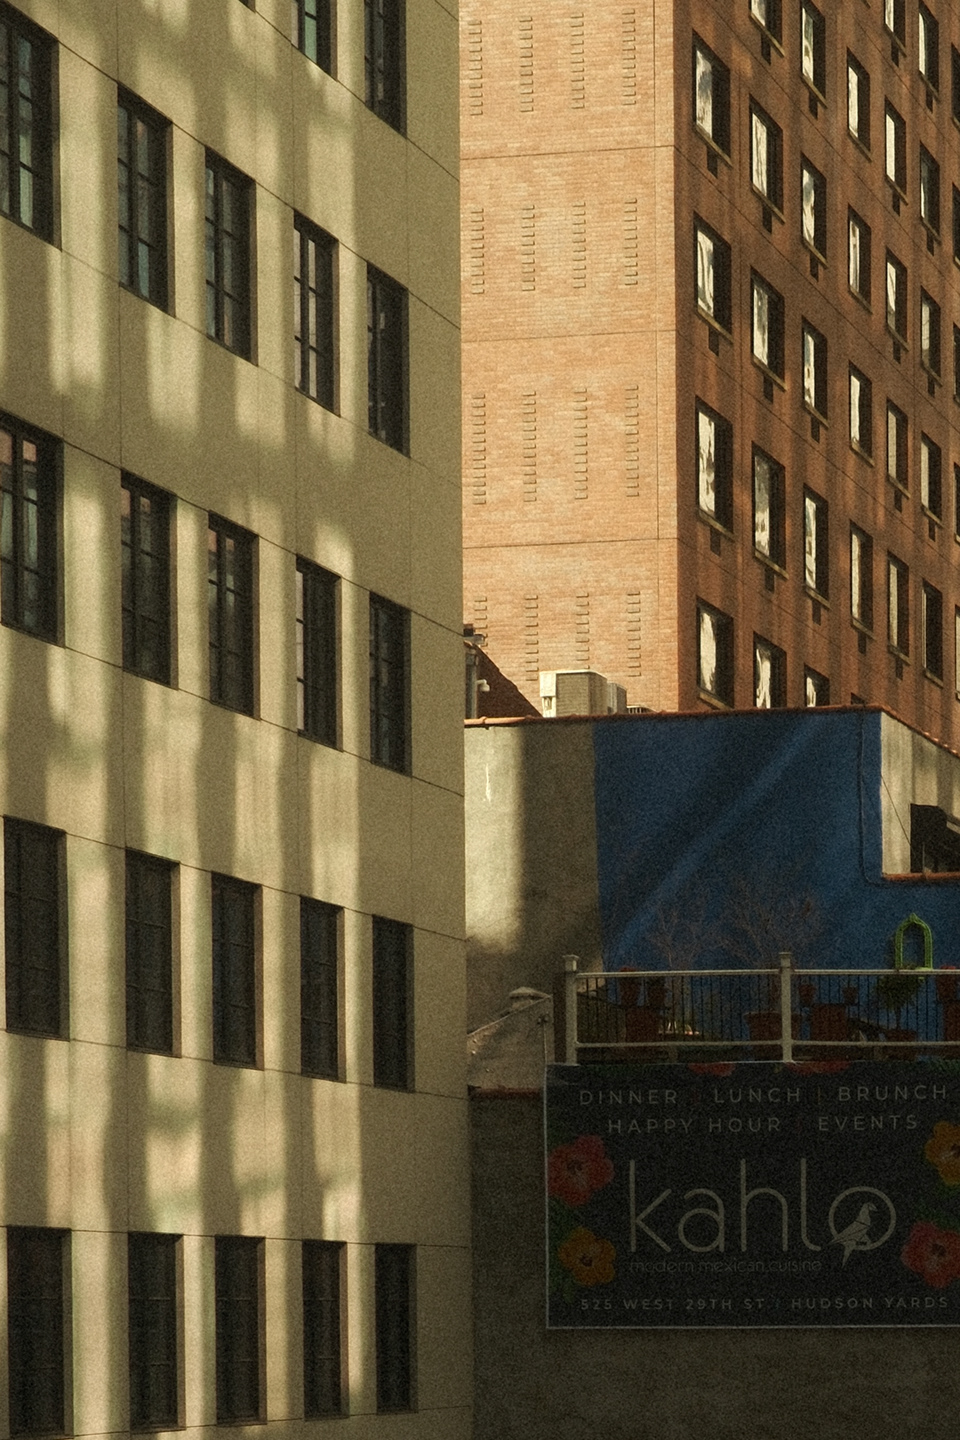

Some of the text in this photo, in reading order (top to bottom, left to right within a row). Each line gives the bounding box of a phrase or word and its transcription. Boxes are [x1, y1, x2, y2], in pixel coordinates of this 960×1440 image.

[580, 1084, 947, 1106] DINNER LUNCH BRUNCH
[608, 1114, 918, 1135] HAPPY HOUR EVENTS
[629, 1157, 897, 1253] kahlo
[630, 1256, 823, 1273] modern mexican cuisine
[581, 1296, 948, 1311] 525 WEST 29TH ST HUDSON YARDS
